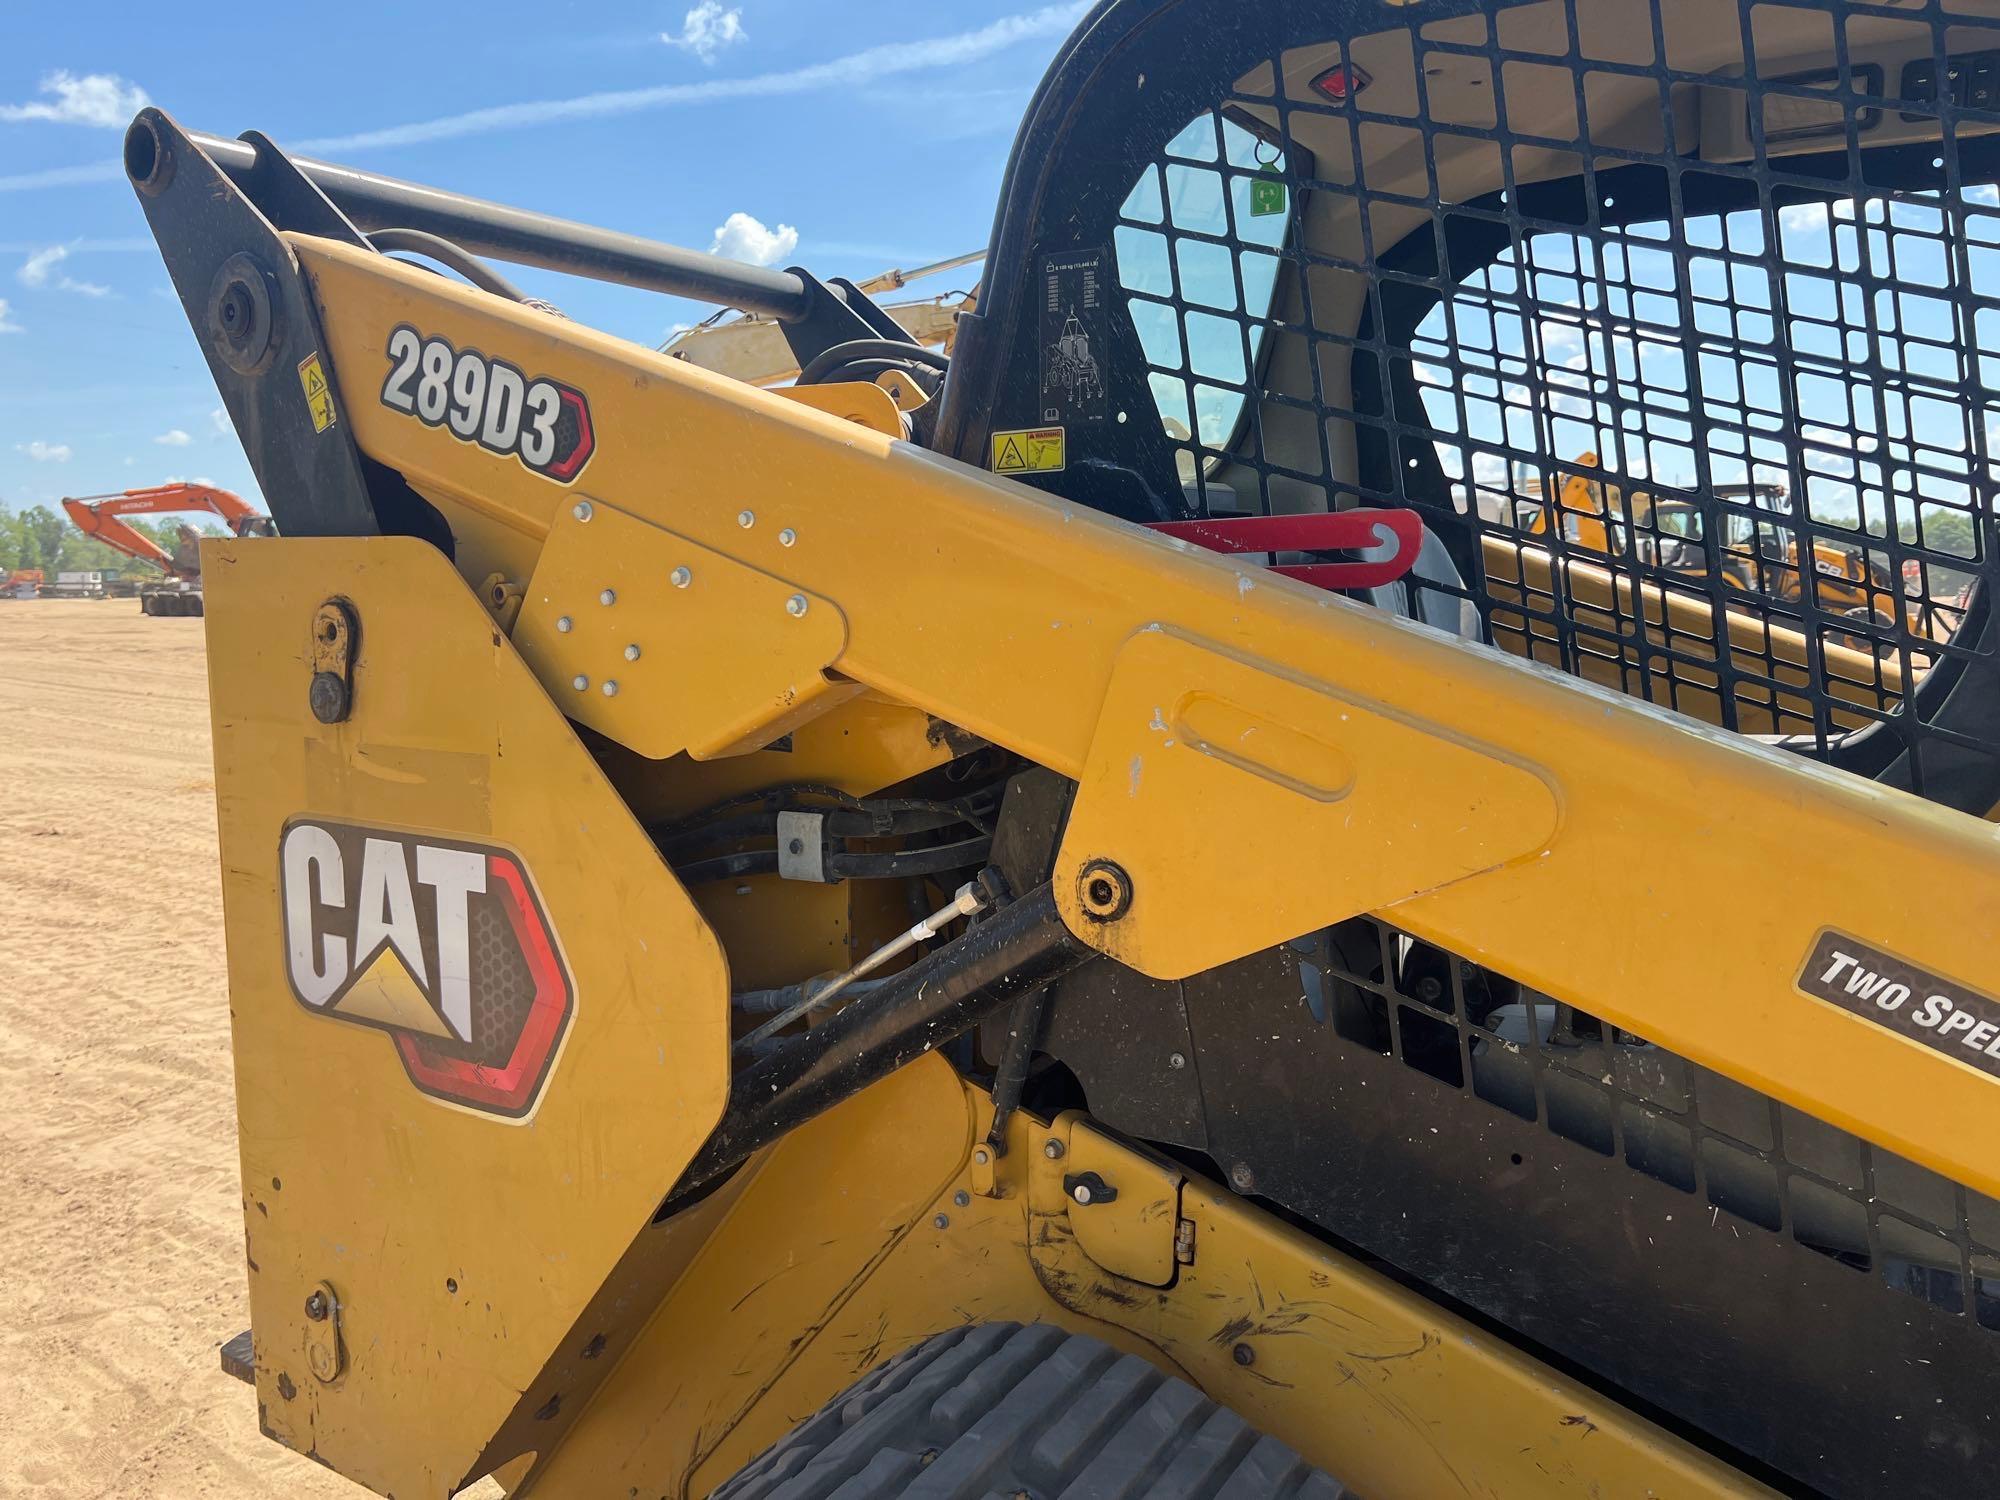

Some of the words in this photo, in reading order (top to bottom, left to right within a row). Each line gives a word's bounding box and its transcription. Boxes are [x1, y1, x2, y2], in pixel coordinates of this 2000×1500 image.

[384, 329, 560, 466] 289D3
[1815, 560, 1842, 577] CB
[284, 825, 487, 1043] CAT
